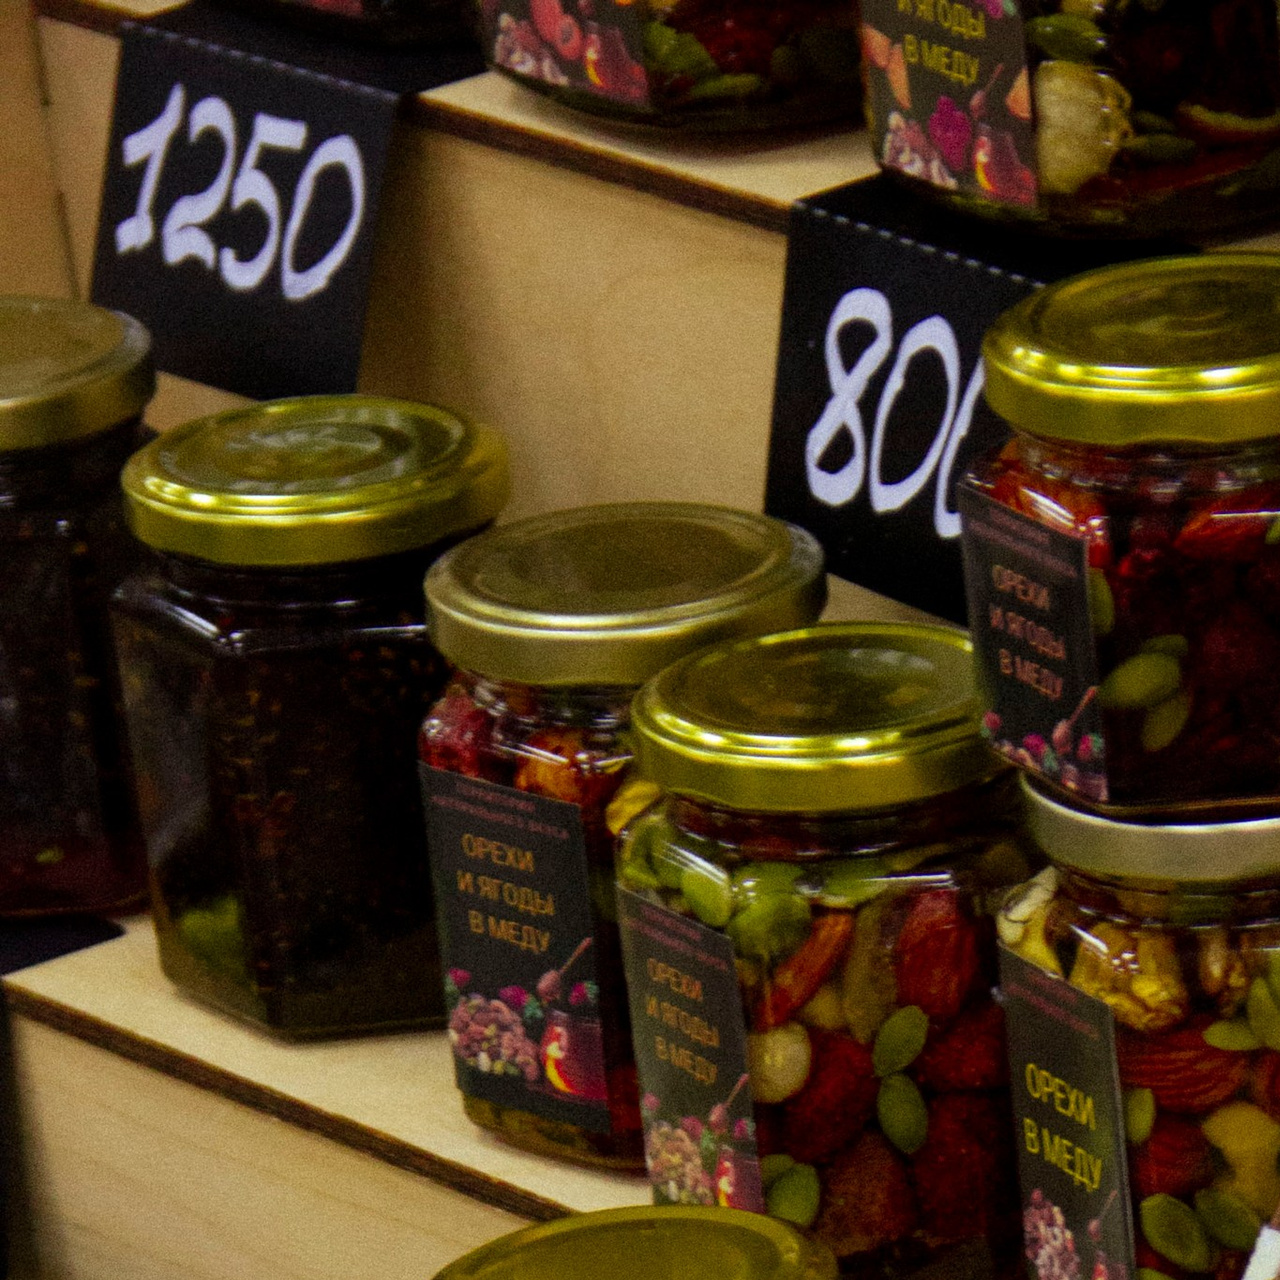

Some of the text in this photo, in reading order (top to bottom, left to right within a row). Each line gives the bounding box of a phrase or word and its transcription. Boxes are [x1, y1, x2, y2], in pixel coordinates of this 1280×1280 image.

[920, 39, 980, 86] МЕДУ
[114, 80, 366, 302] 1250
[462, 832, 535, 874] ОРЕХИ
[456, 869, 556, 917] И ЯГОДЫ
[468, 909, 552, 954] В МЕДУ
[1025, 1062, 1097, 1131] ОРЕХИ
[1023, 1117, 1102, 1193] В МЕДУ
